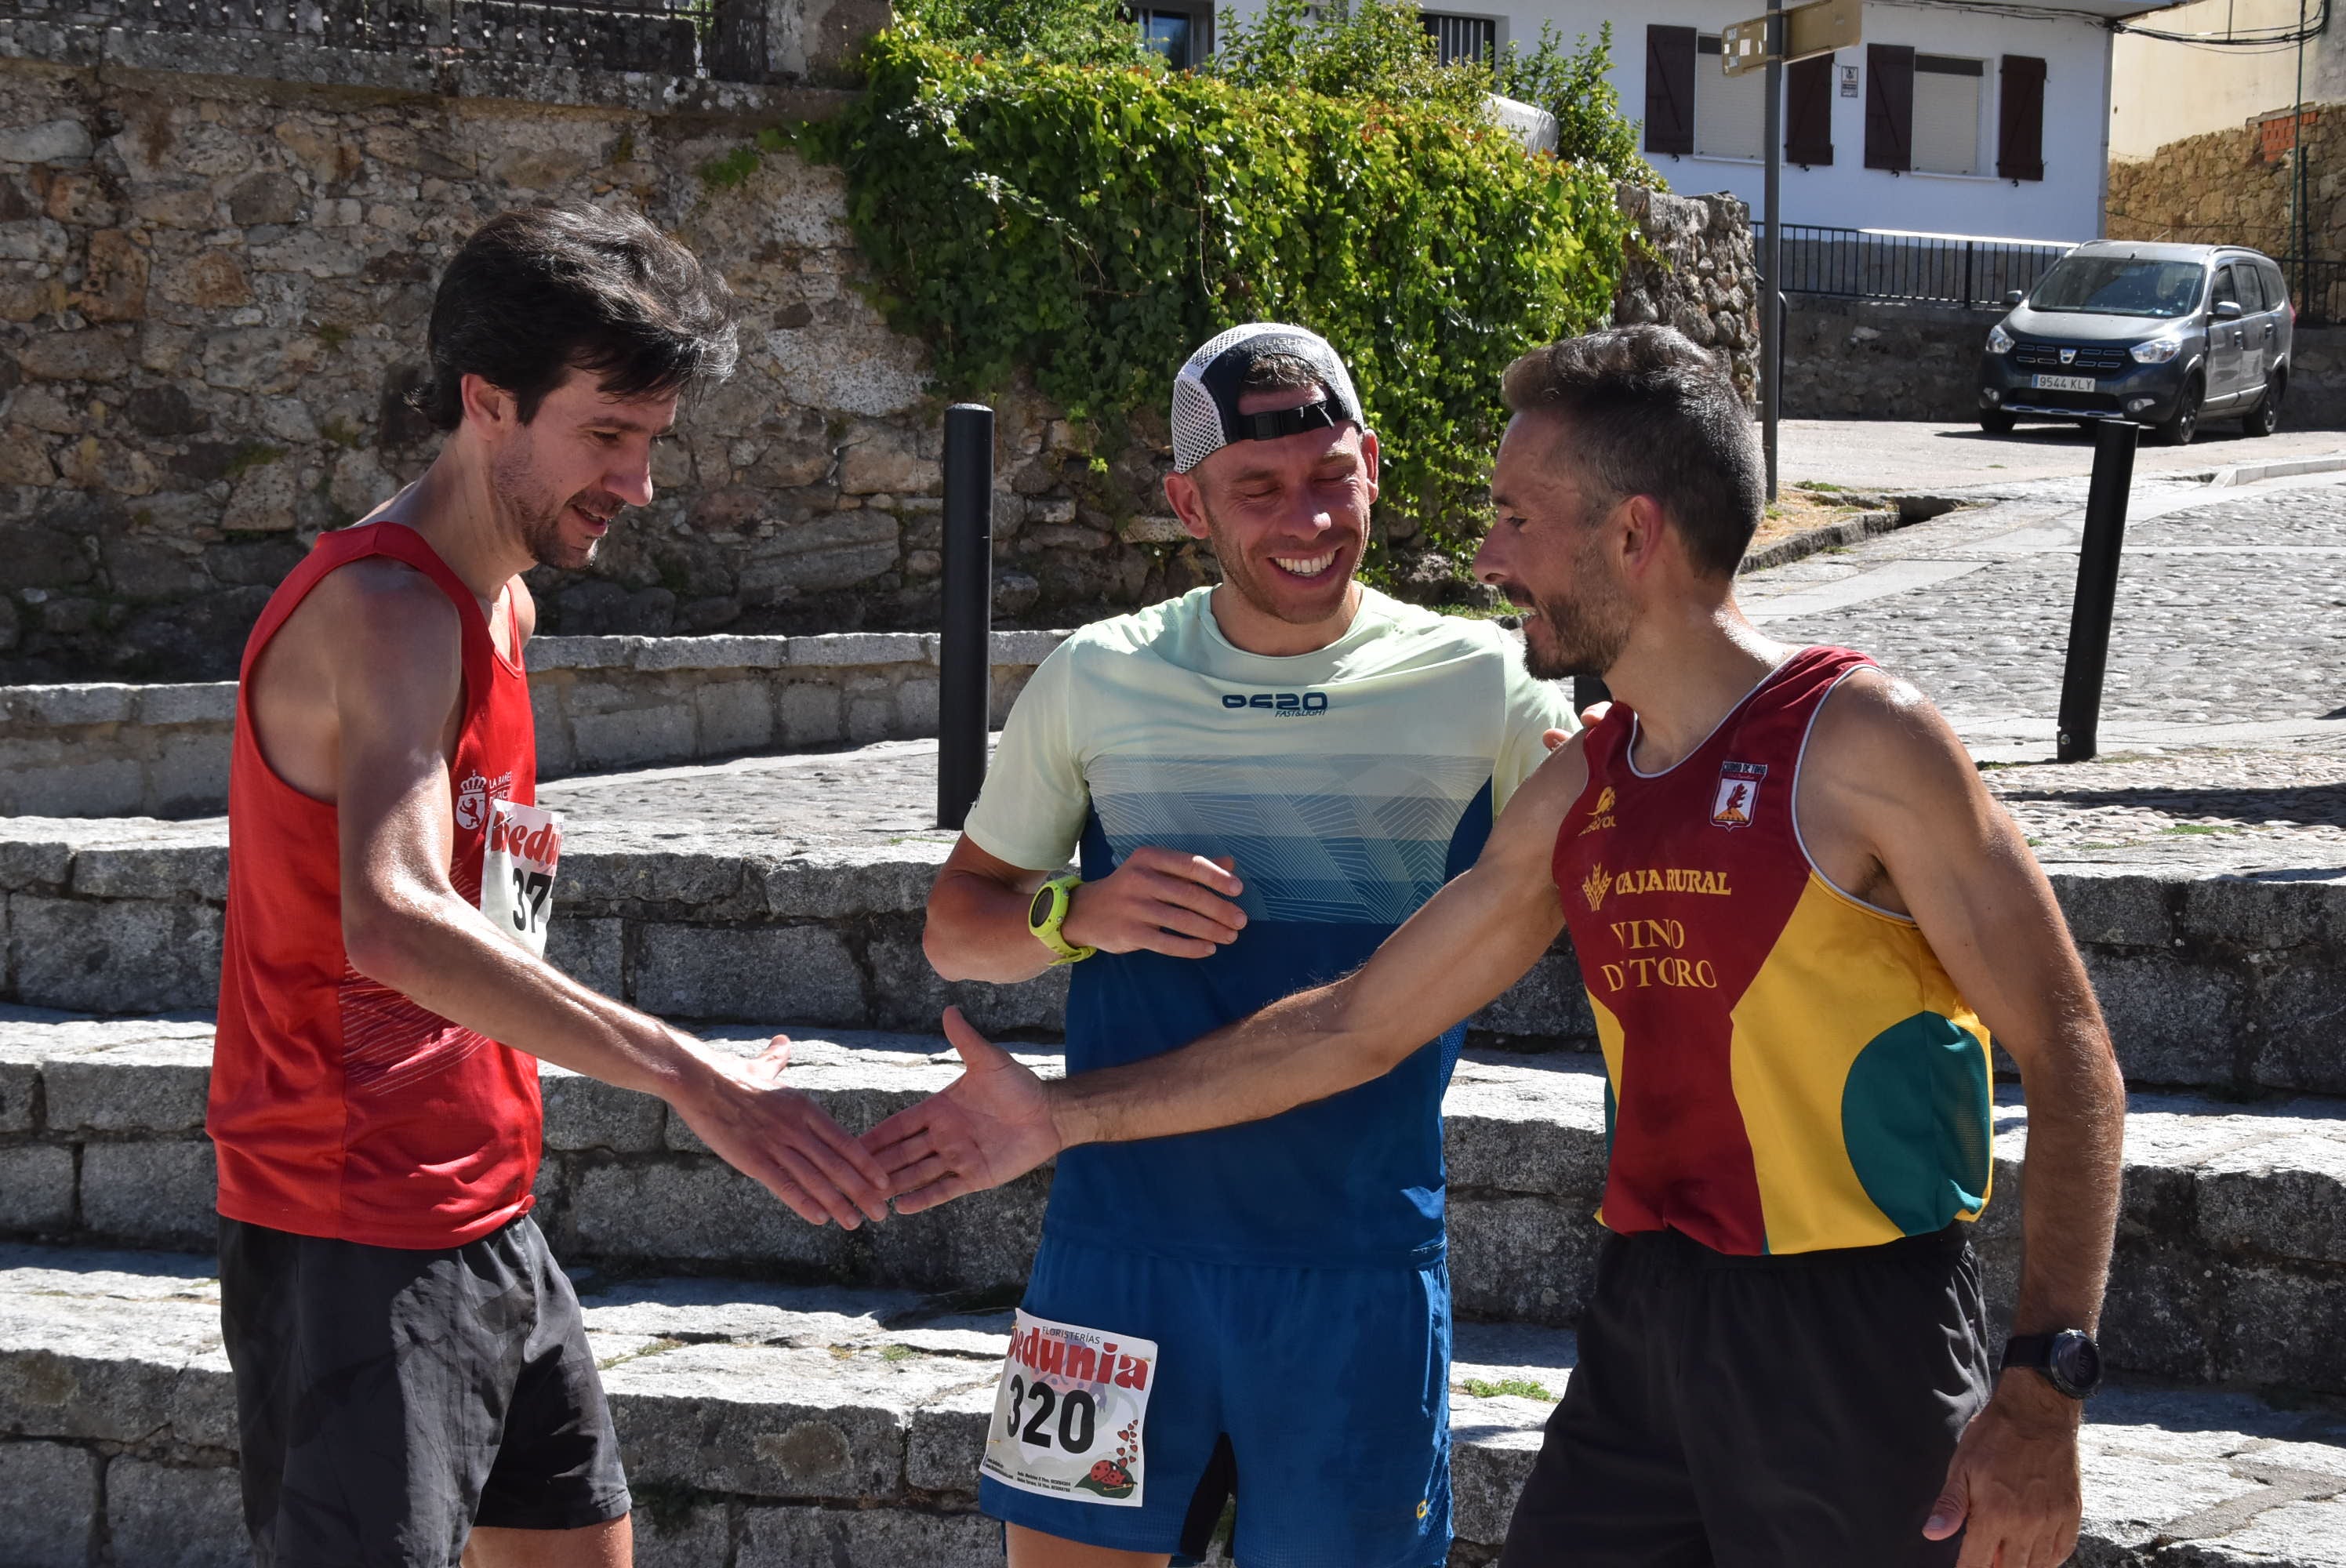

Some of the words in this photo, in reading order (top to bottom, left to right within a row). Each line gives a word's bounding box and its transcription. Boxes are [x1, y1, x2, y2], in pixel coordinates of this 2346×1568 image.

[2039, 376, 2066, 389] 9544
[2070, 378, 2093, 390] KLY
[1275, 709, 1327, 718] FAST&LIGHT
[488, 778, 497, 789] LA
[512, 867, 555, 933] 37
[1610, 918, 1685, 949] VINO
[1042, 1326, 1101, 1345] FLORISTERÍAS
[1007, 1374, 1095, 1454] 320
